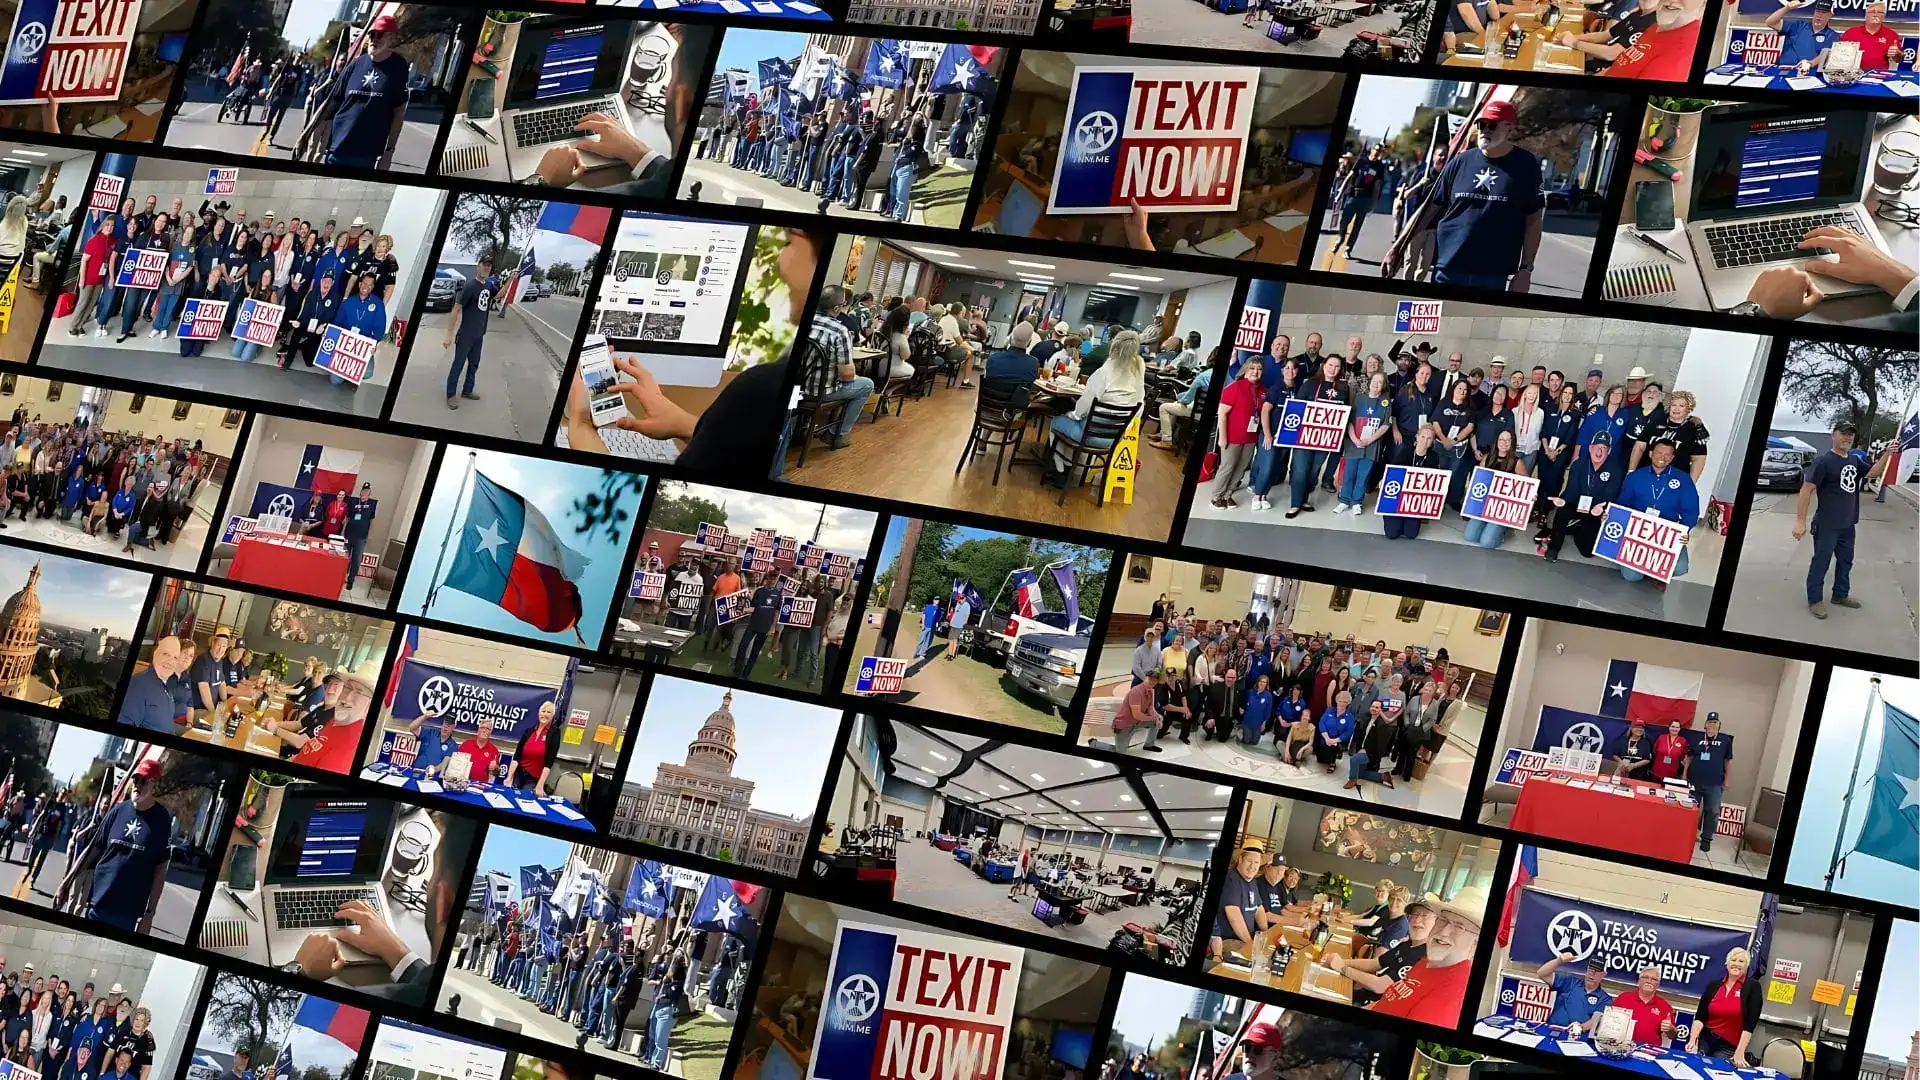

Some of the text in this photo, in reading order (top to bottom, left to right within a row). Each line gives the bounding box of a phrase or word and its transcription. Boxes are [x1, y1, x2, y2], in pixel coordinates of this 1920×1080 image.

[57, 0, 136, 37] TEXIT
[41, 48, 121, 91] NOW!
[1133, 80, 1247, 130] TEXIT
[1120, 145, 1232, 198] NOW!
[96, 176, 122, 193] TEXIT
[90, 192, 118, 210] NOW!
[138, 253, 166, 269] TEXIT
[132, 270, 161, 286] NOW!
[197, 303, 226, 319] TEXIT
[253, 304, 283, 323] TEXIT
[1240, 310, 1266, 329] XIT
[1412, 304, 1440, 316] TEXIT
[192, 321, 219, 338] NOW!
[247, 323, 276, 346] NOW!
[1410, 317, 1437, 331] NOW!
[337, 333, 373, 357] TEXIT
[330, 352, 365, 381] NOW!
[1305, 405, 1346, 426] TEXIT
[1300, 427, 1339, 447] NOW!
[1404, 471, 1447, 492] TEXIT
[1491, 475, 1535, 499] TEXIT
[1399, 493, 1439, 514] NOW!
[1485, 498, 1527, 524] NOW!
[1629, 515, 1681, 549] TEXIT
[1620, 539, 1671, 575] NOW!
[678, 596, 699, 609] NOW!
[876, 661, 906, 675] TEXIT
[457, 683, 495, 701] TEXAS
[872, 676, 901, 691] NOW!
[453, 695, 528, 721] NATIONALIST
[1519, 754, 1548, 770] TEXIT
[1603, 920, 1658, 944] TEXAS
[1597, 935, 1710, 970] NATIONALIST
[897, 944, 1011, 1015] TEXIT
[1515, 1004, 1550, 1022] NOW!
[880, 1019, 994, 1080] NOW!
